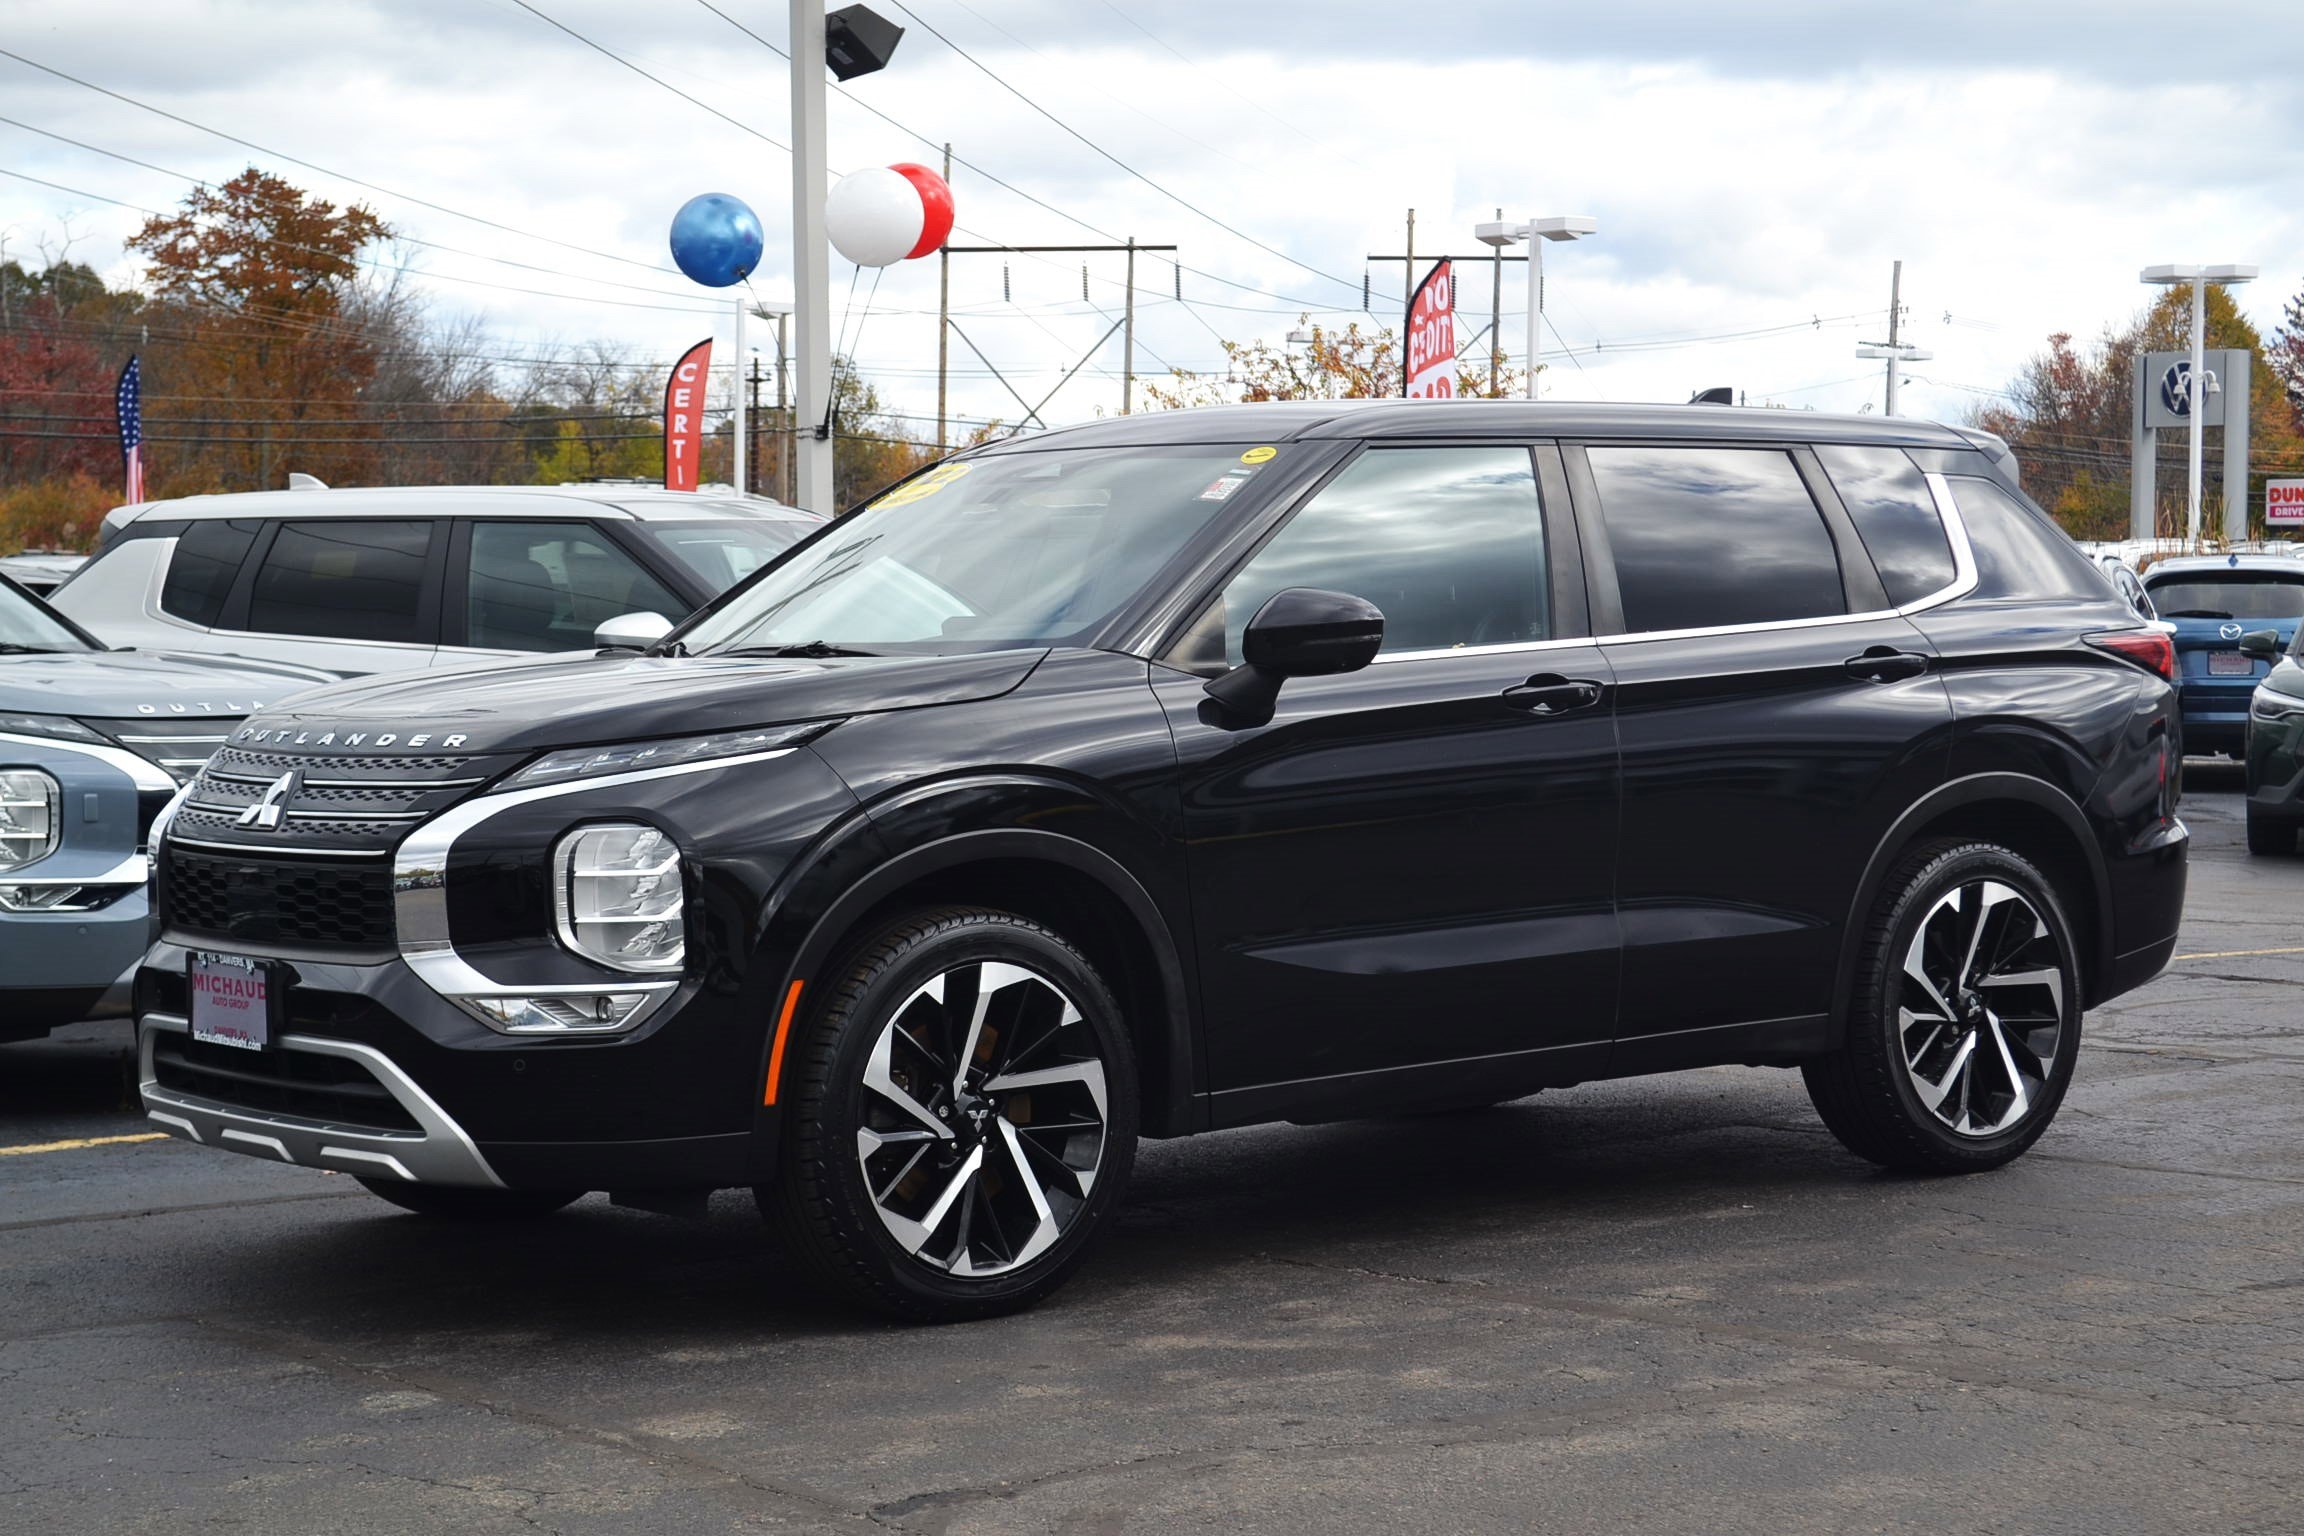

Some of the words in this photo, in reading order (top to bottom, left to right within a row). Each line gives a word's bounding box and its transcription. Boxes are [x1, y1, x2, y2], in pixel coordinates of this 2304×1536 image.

[672, 362, 698, 485] CERTI
[2269, 487, 2304, 503] DUN
[239, 728, 468, 748] OUTLANDER
[193, 973, 267, 1000] MICHAUD
